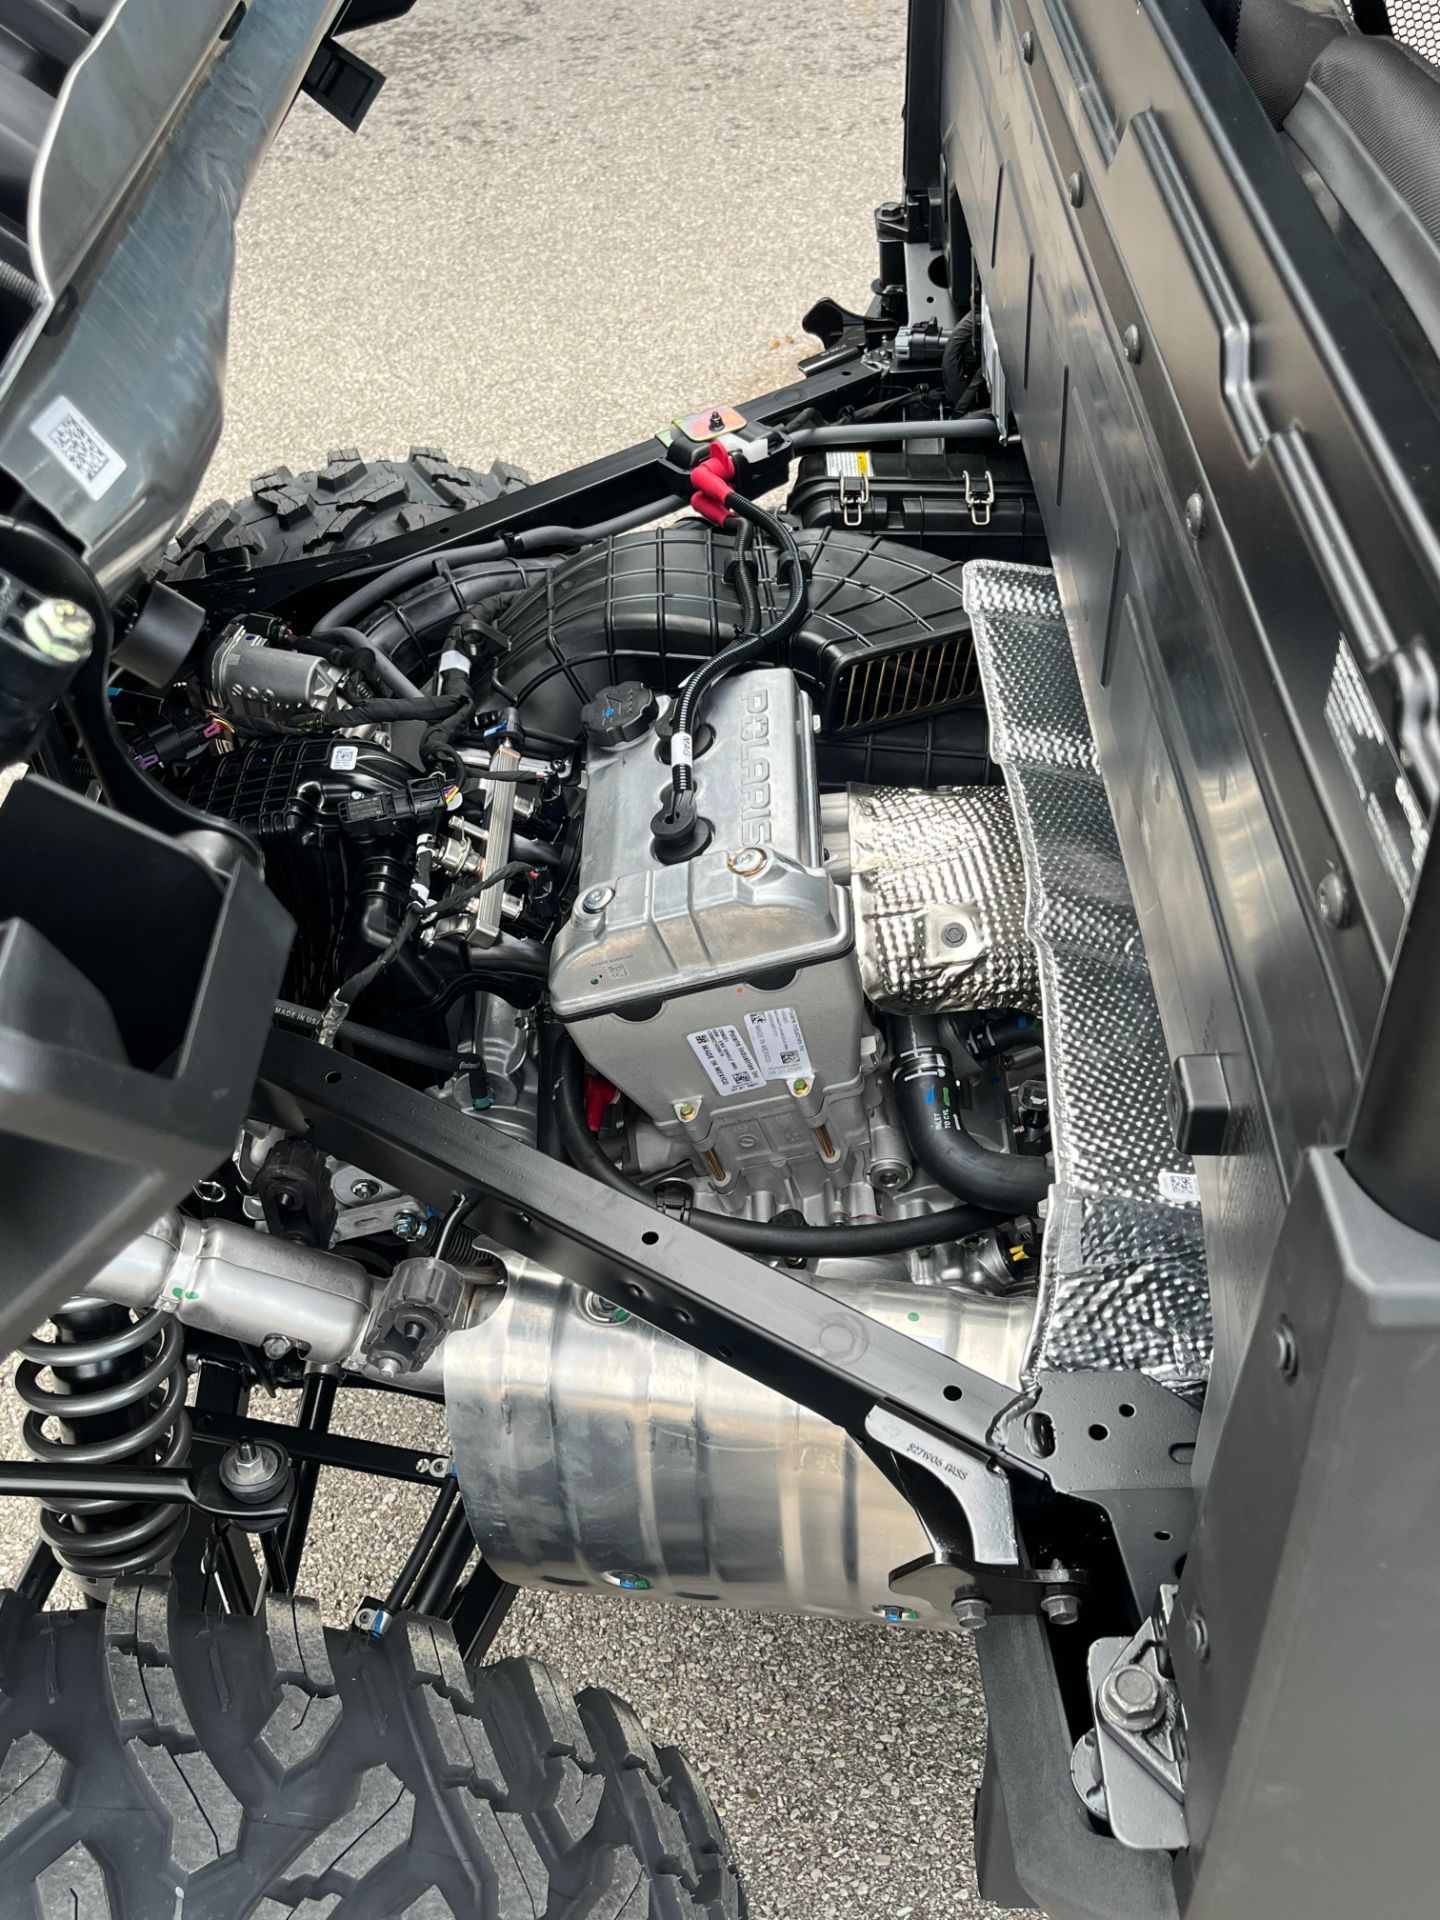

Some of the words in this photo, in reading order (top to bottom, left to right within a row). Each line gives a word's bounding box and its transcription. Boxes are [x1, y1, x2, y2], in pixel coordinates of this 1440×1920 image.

[682, 735, 691, 757] MAG
[741, 688, 772, 847] POLARIS
[274, 1006, 296, 1018] MADE
[296, 1013, 306, 1021] IN
[702, 1045, 714, 1059] MADE
[715, 1067, 729, 1085] MEXICO
[933, 1113, 942, 1130] INLET
[942, 1108, 950, 1120] CYL
[944, 1121, 951, 1129] TO
